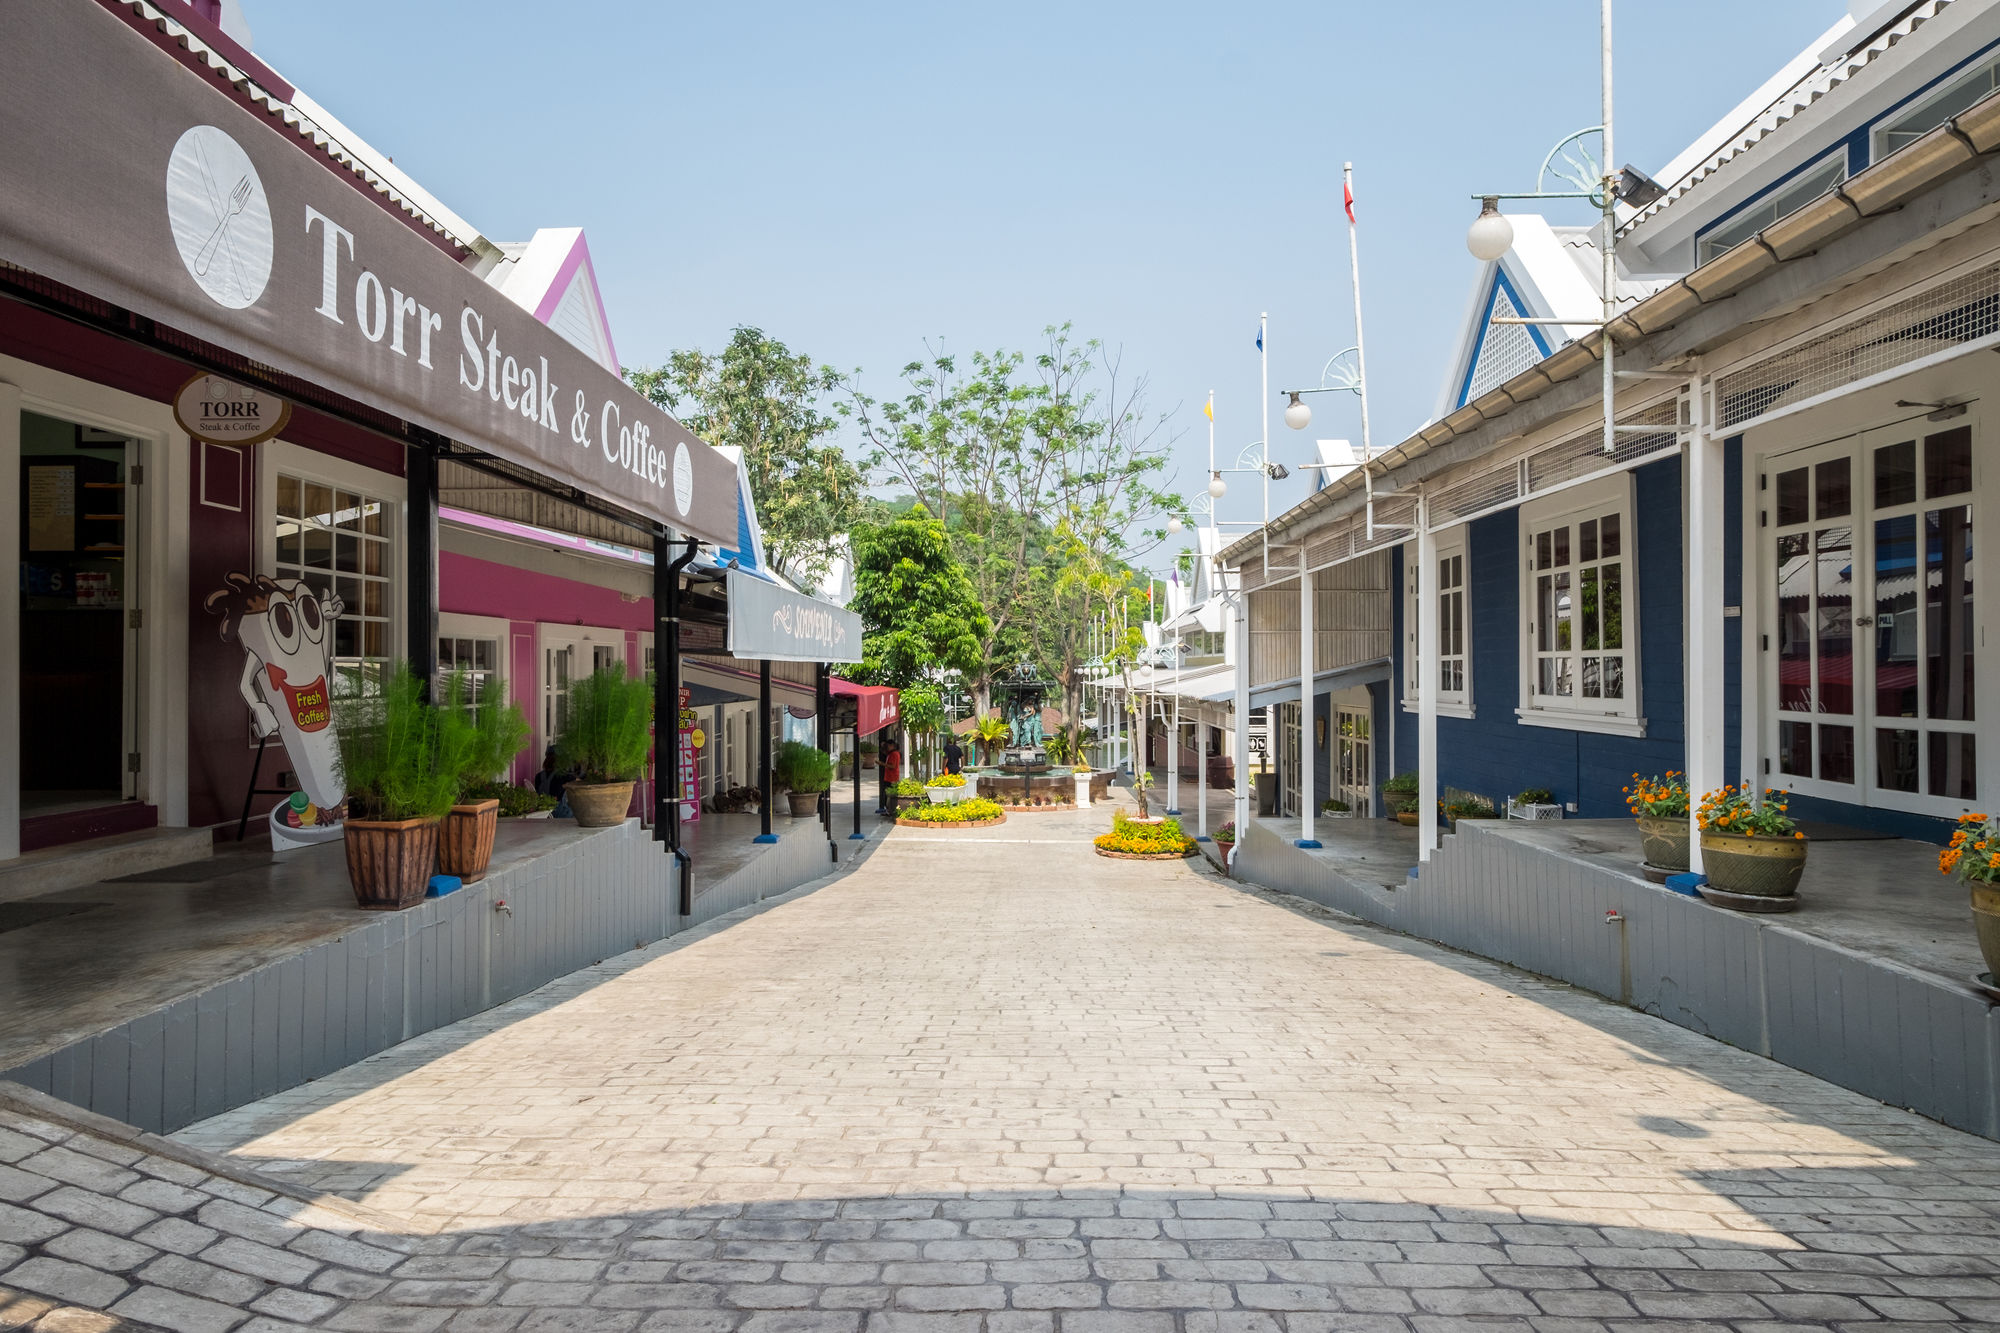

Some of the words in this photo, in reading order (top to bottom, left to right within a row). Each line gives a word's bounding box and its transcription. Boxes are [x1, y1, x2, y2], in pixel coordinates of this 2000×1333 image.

[305, 204, 442, 371] Torr
[459, 306, 560, 434] Steak
[571, 389, 591, 449] &
[601, 400, 667, 489] Coffee
[200, 401, 260, 417] TORR
[200, 422, 221, 431] Steak
[224, 423, 230, 431] &
[232, 422, 260, 431] Coffee
[1879, 616, 1892, 624] PULL
[296, 690, 322, 708] Fresh
